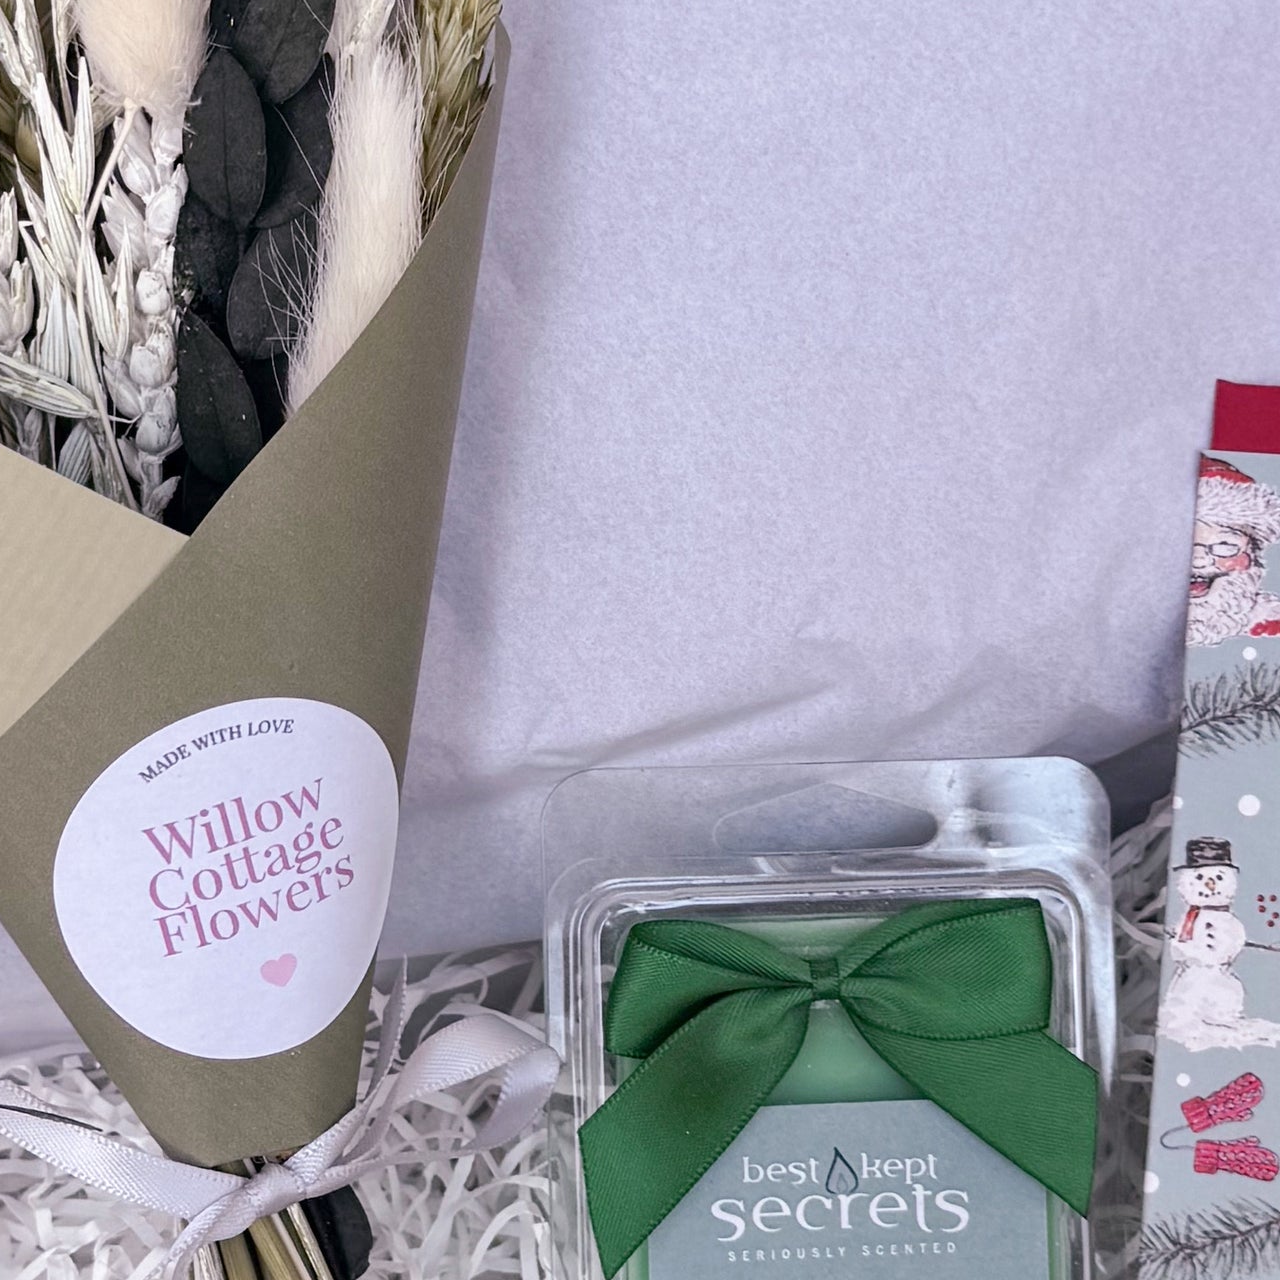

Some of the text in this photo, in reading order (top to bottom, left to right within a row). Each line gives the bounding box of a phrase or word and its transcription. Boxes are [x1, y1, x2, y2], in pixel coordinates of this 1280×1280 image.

[137, 718, 295, 784] MADE WITH LOVE
[141, 777, 324, 866] Willow
[149, 817, 345, 912] Cottage
[154, 854, 355, 958] Flowers
[741, 1152, 938, 1185] best kept
[710, 1184, 970, 1242] secrets
[727, 1241, 958, 1263] SERIOUSLY SCENTED
